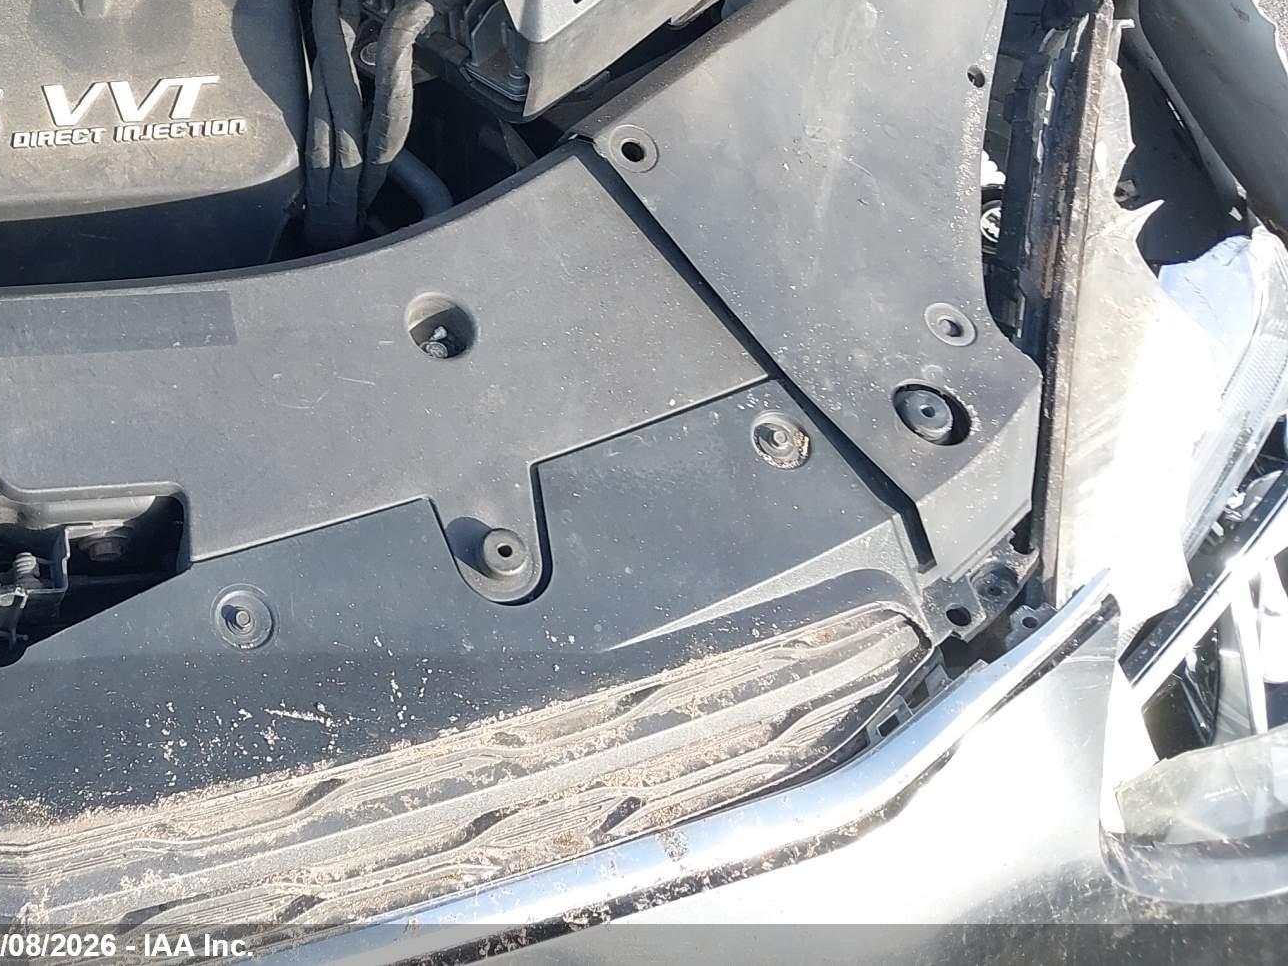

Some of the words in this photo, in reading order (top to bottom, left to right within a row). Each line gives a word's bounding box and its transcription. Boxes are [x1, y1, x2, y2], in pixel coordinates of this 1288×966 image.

[41, 75, 220, 126] VVT
[10, 126, 106, 150] DIRECT
[113, 118, 249, 143] INJECTION
